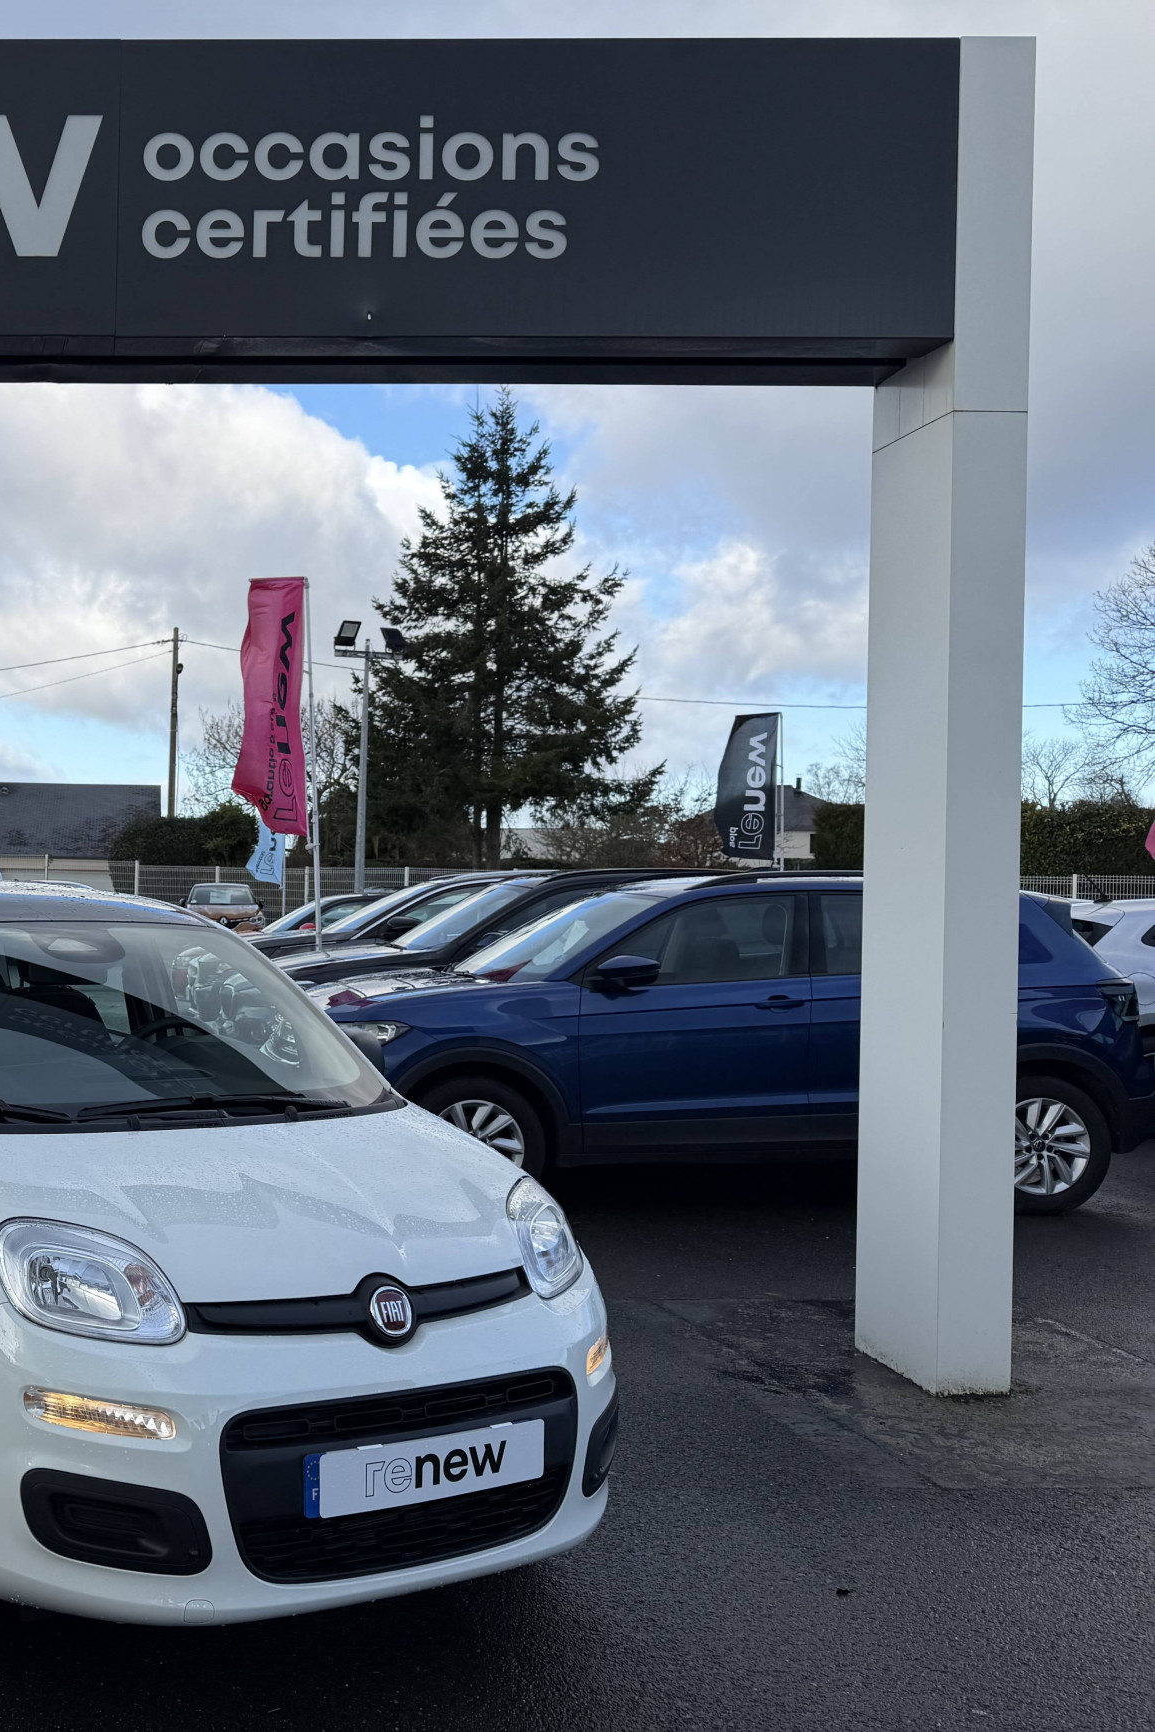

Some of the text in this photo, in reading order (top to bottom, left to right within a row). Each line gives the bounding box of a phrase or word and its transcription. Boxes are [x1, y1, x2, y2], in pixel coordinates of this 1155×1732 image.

[142, 114, 600, 181] occasions
[141, 191, 568, 259] certifiées
[379, 1300, 406, 1323] FIAT
[365, 1440, 507, 1498] renew
